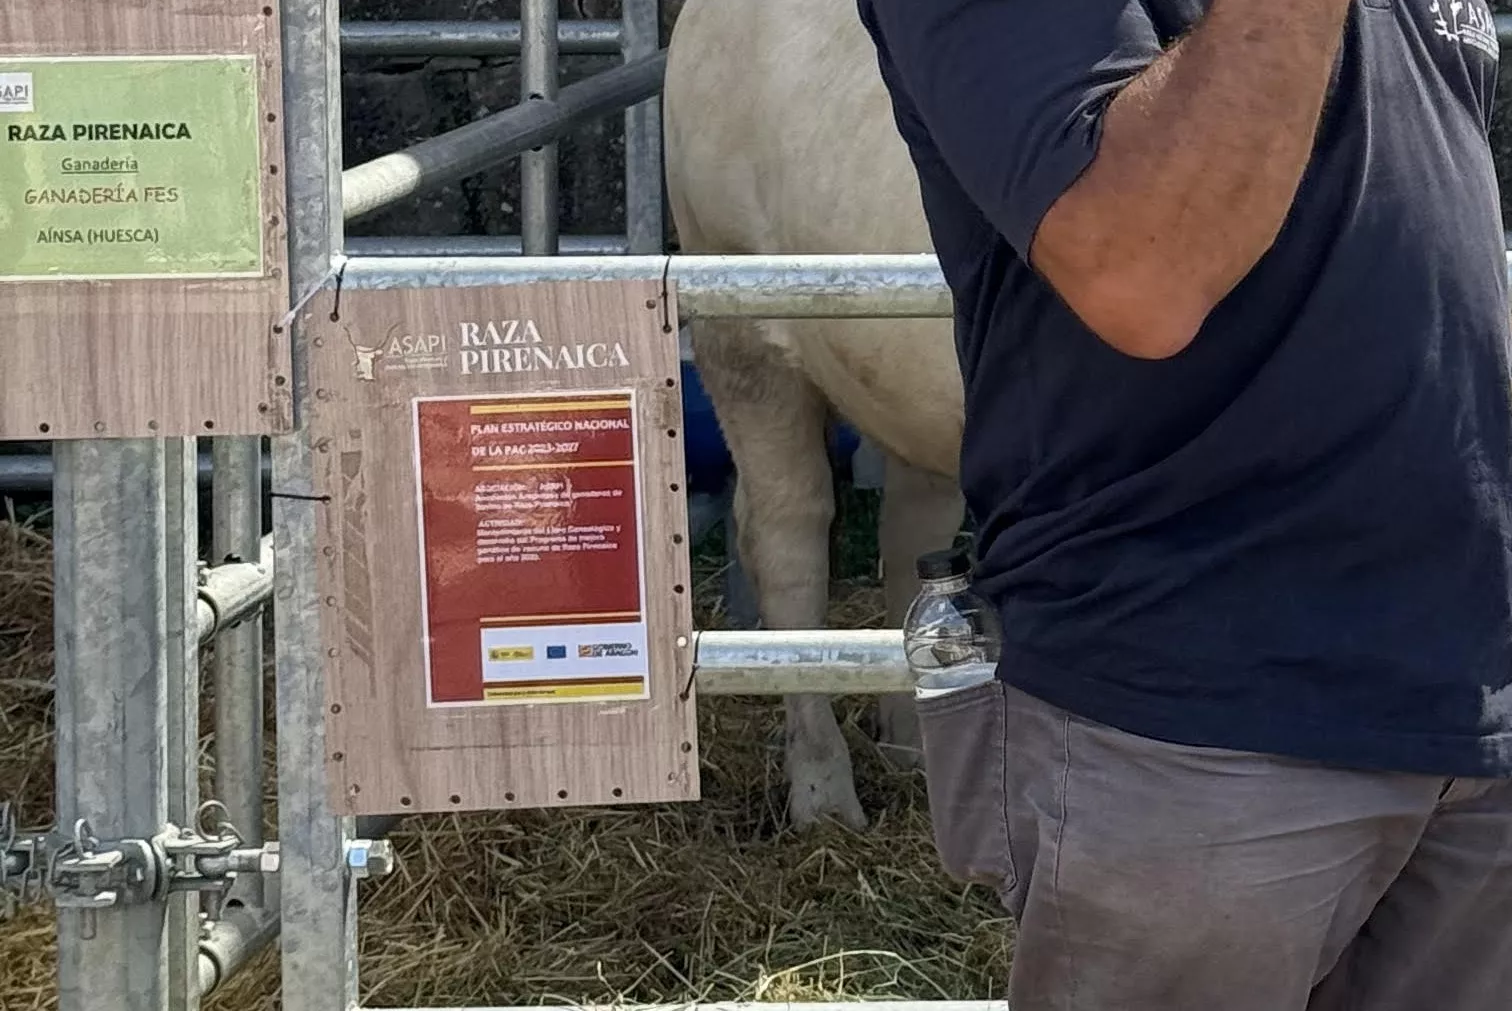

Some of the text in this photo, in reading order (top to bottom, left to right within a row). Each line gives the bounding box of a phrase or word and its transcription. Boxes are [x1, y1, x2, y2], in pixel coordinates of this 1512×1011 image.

[0, 85, 29, 99] API
[8, 122, 192, 142] RAZA PIRENAICA
[61, 155, 139, 172] Ganadería
[143, 186, 179, 203] FES
[36, 227, 160, 246] AÍNSA (HUESCA)
[459, 319, 543, 347] RAZA
[388, 334, 447, 357] ASAPI
[459, 342, 631, 375] PIRENAICA
[470, 424, 499, 435] PLAN
[574, 419, 630, 431] NACIONAL
[471, 445, 487, 457] DE
[488, 444, 503, 456] LA
[504, 444, 527, 456] PAC
